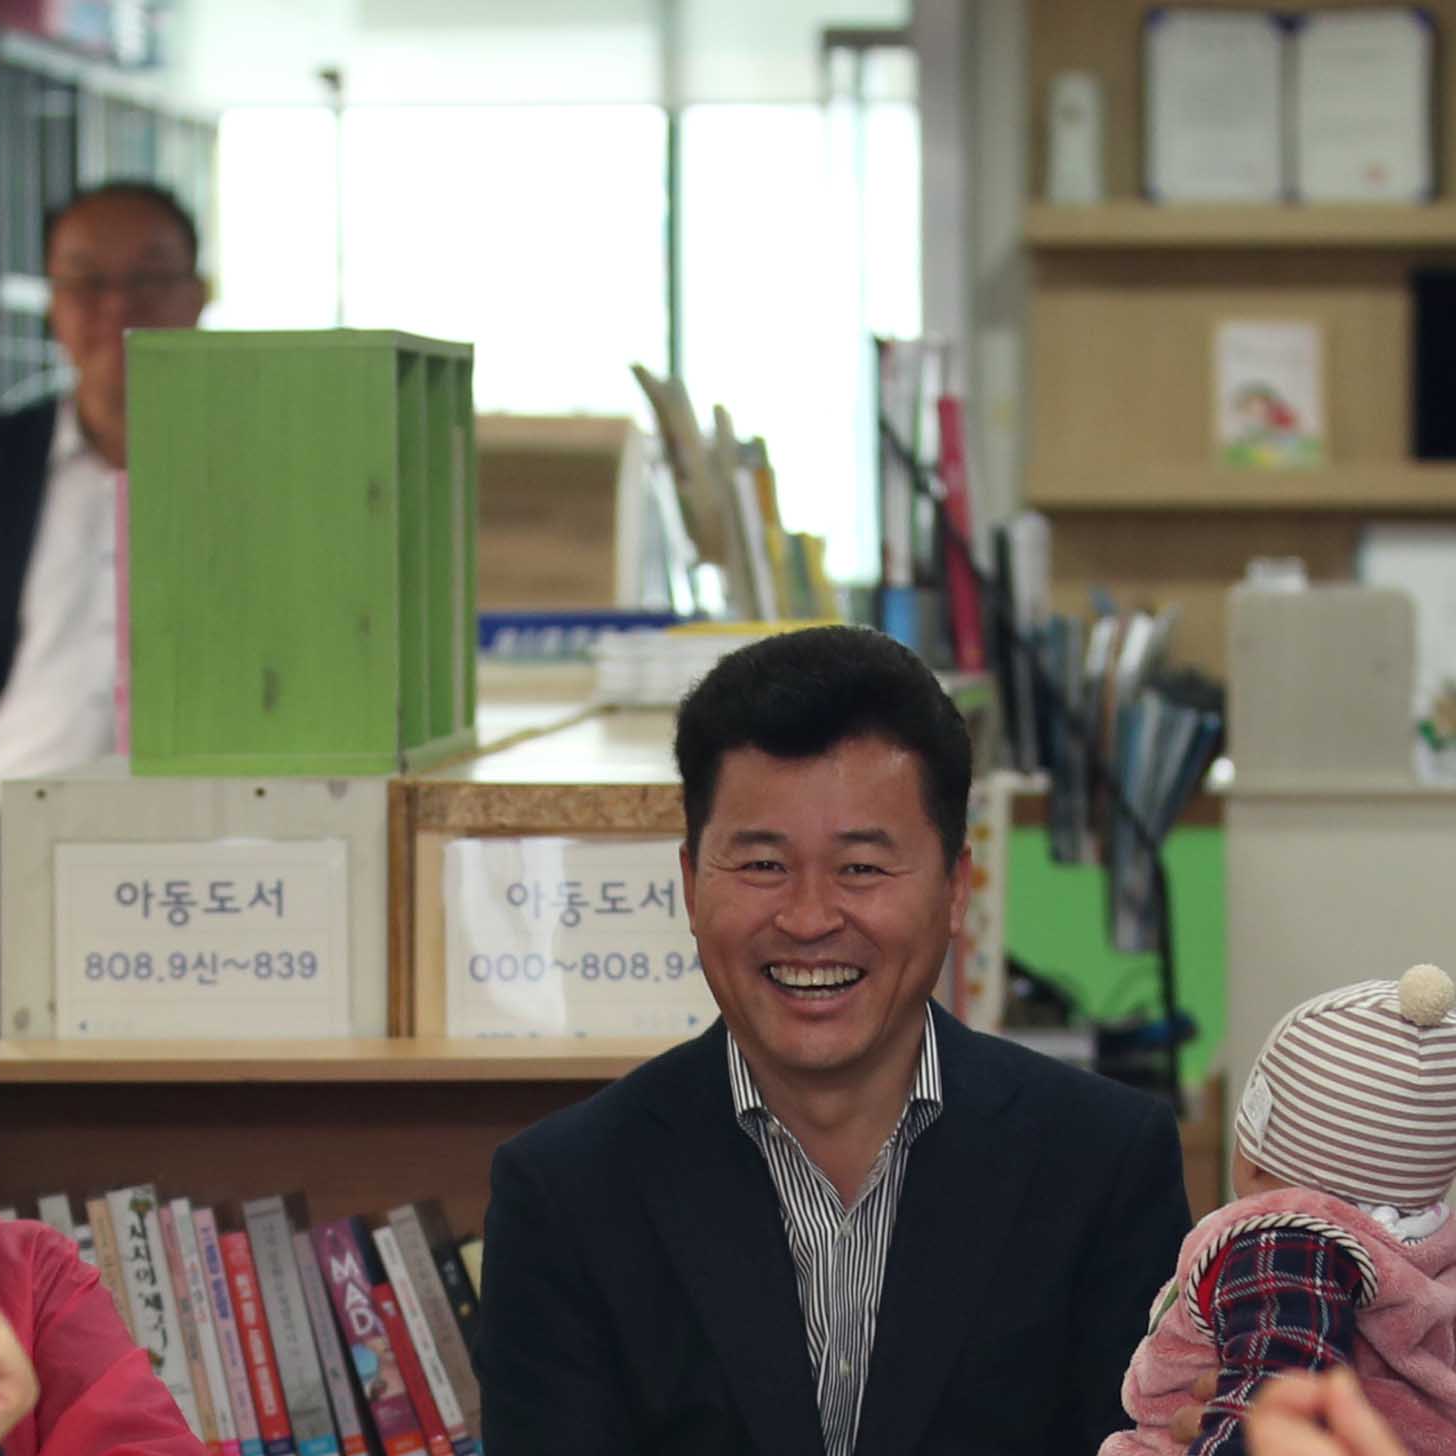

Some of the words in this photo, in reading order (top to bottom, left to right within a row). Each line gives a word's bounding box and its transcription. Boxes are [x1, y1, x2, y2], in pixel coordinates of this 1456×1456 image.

[114, 879, 284, 926] 아동도서
[506, 879, 675, 928] 아동도서
[84, 951, 319, 985] 808.9신~839
